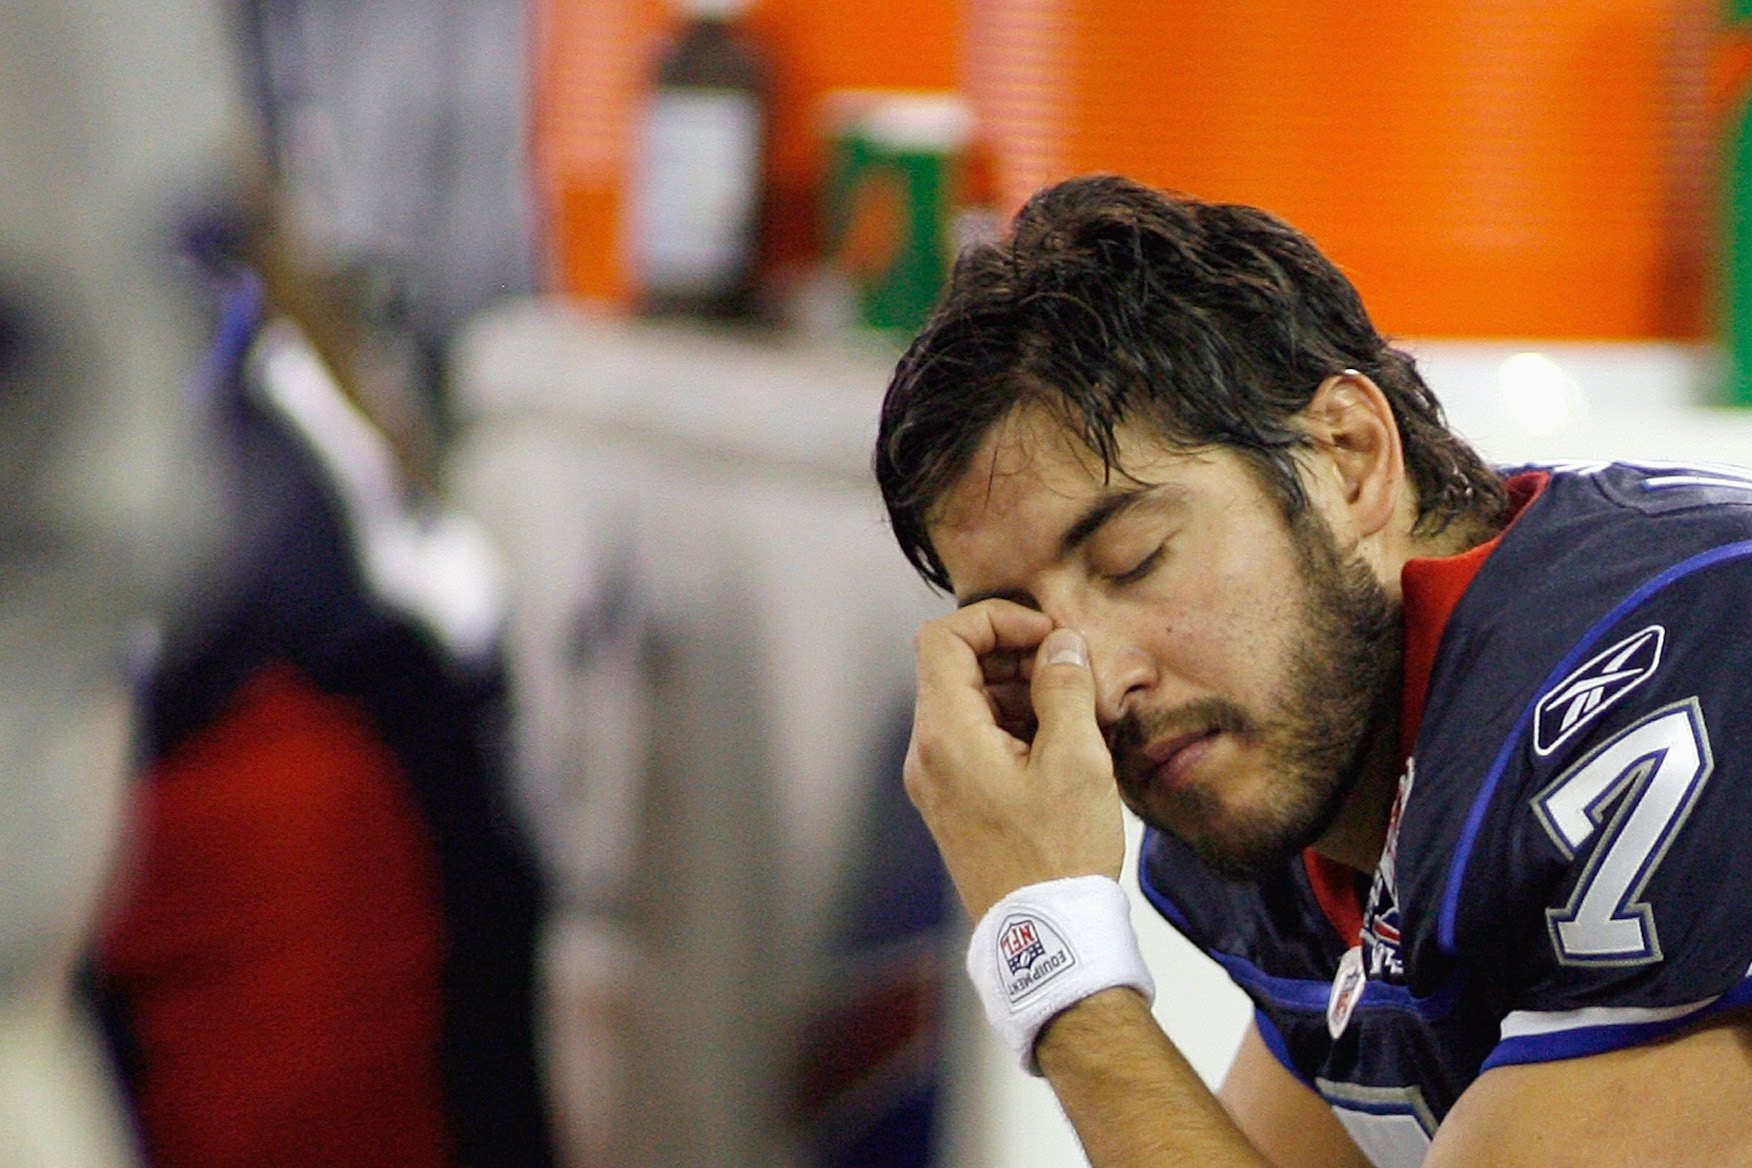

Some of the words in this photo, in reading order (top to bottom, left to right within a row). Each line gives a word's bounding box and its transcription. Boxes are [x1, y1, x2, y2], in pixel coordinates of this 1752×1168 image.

[1530, 696, 1714, 967] 7
[1003, 925, 1034, 954] NFL
[1009, 950, 1067, 995] EQUIPMENT
